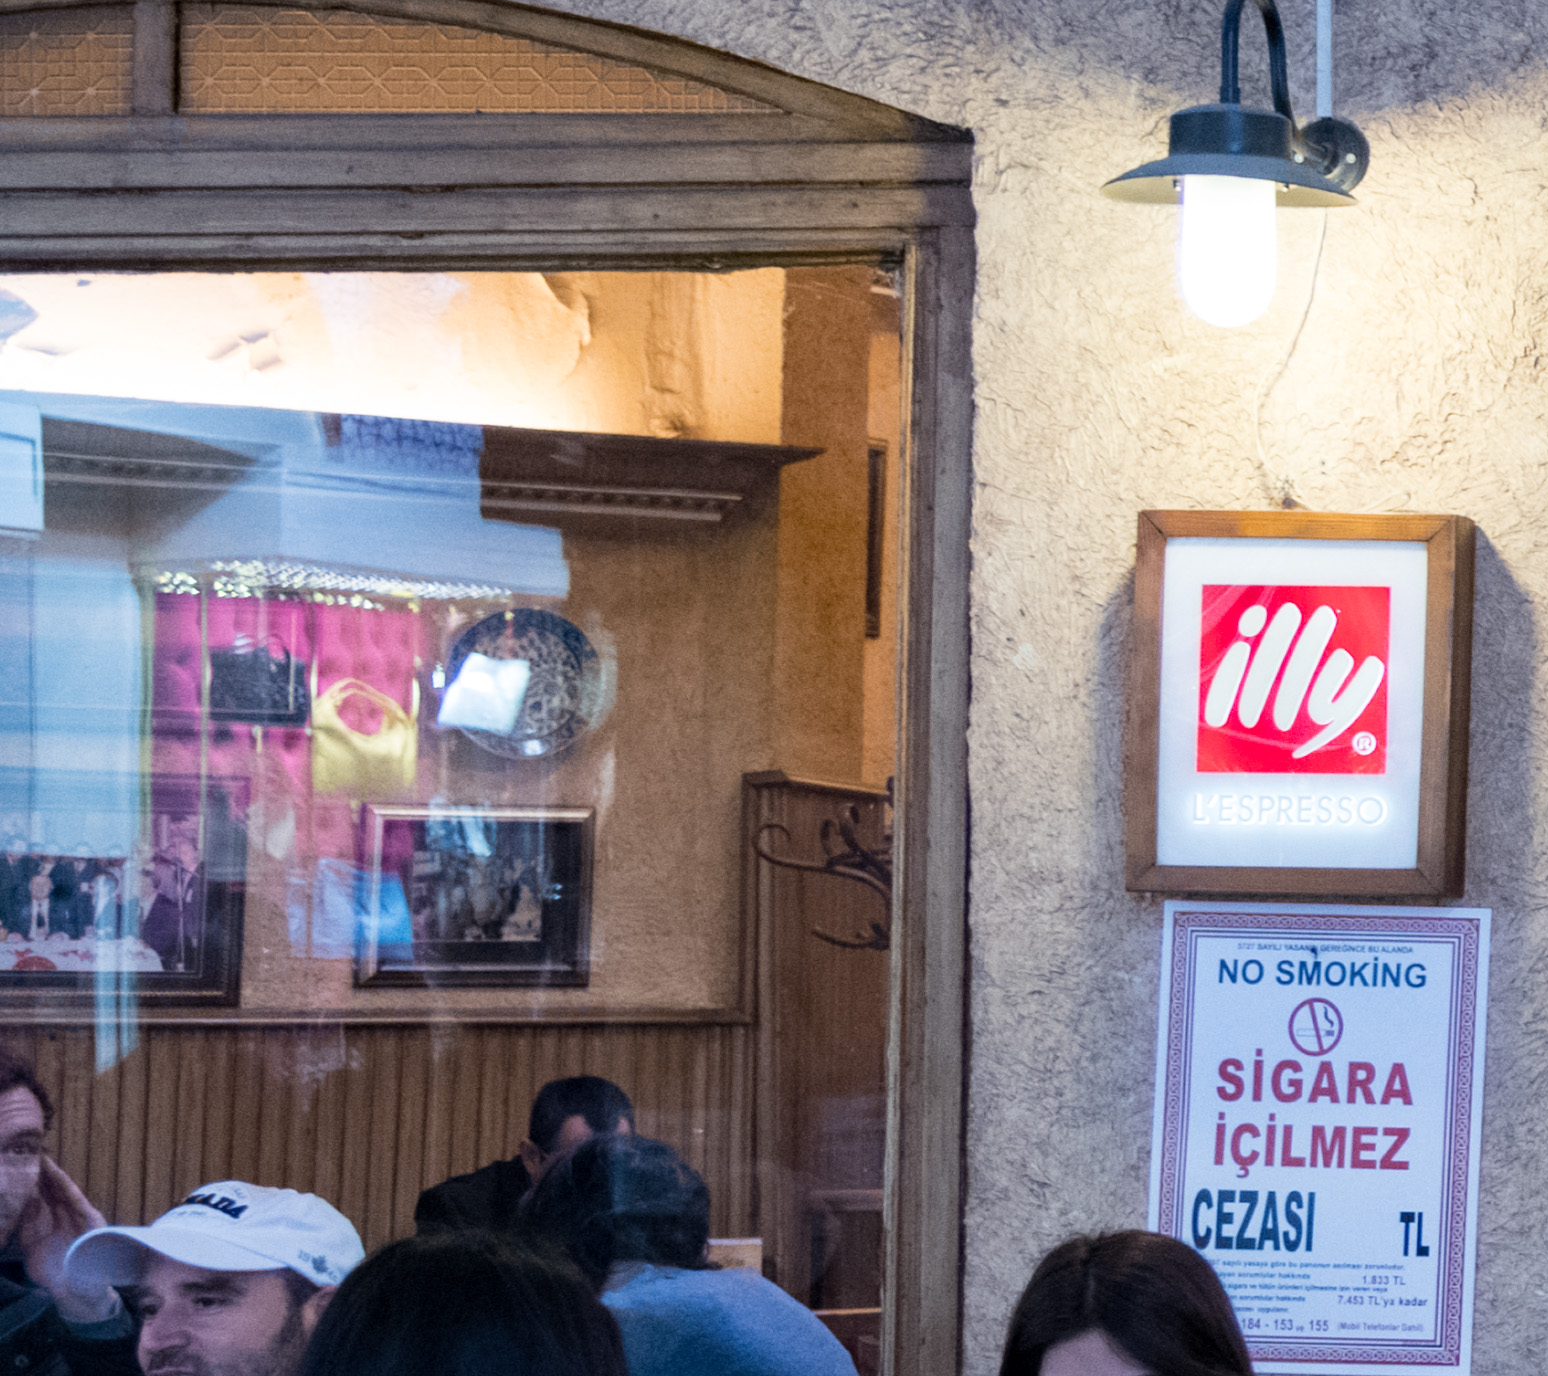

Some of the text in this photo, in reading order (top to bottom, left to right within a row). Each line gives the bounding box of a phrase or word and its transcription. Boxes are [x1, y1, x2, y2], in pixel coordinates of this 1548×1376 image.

[1204, 601, 1386, 760] illy
[1192, 792, 1389, 826] L'ESPRESSO
[1218, 956, 1428, 989] NO SMOKİNG
[1215, 1048, 1414, 1106] SİGARA
[1213, 1112, 1412, 1179] İÇİLMEZ
[1192, 1187, 1430, 1257] CEZASI TL
[1393, 1276, 1406, 1286] TL
[1399, 1297, 1429, 1307] kadar
[1274, 1318, 1294, 1331] 153
[1309, 1319, 1329, 1332] 155
